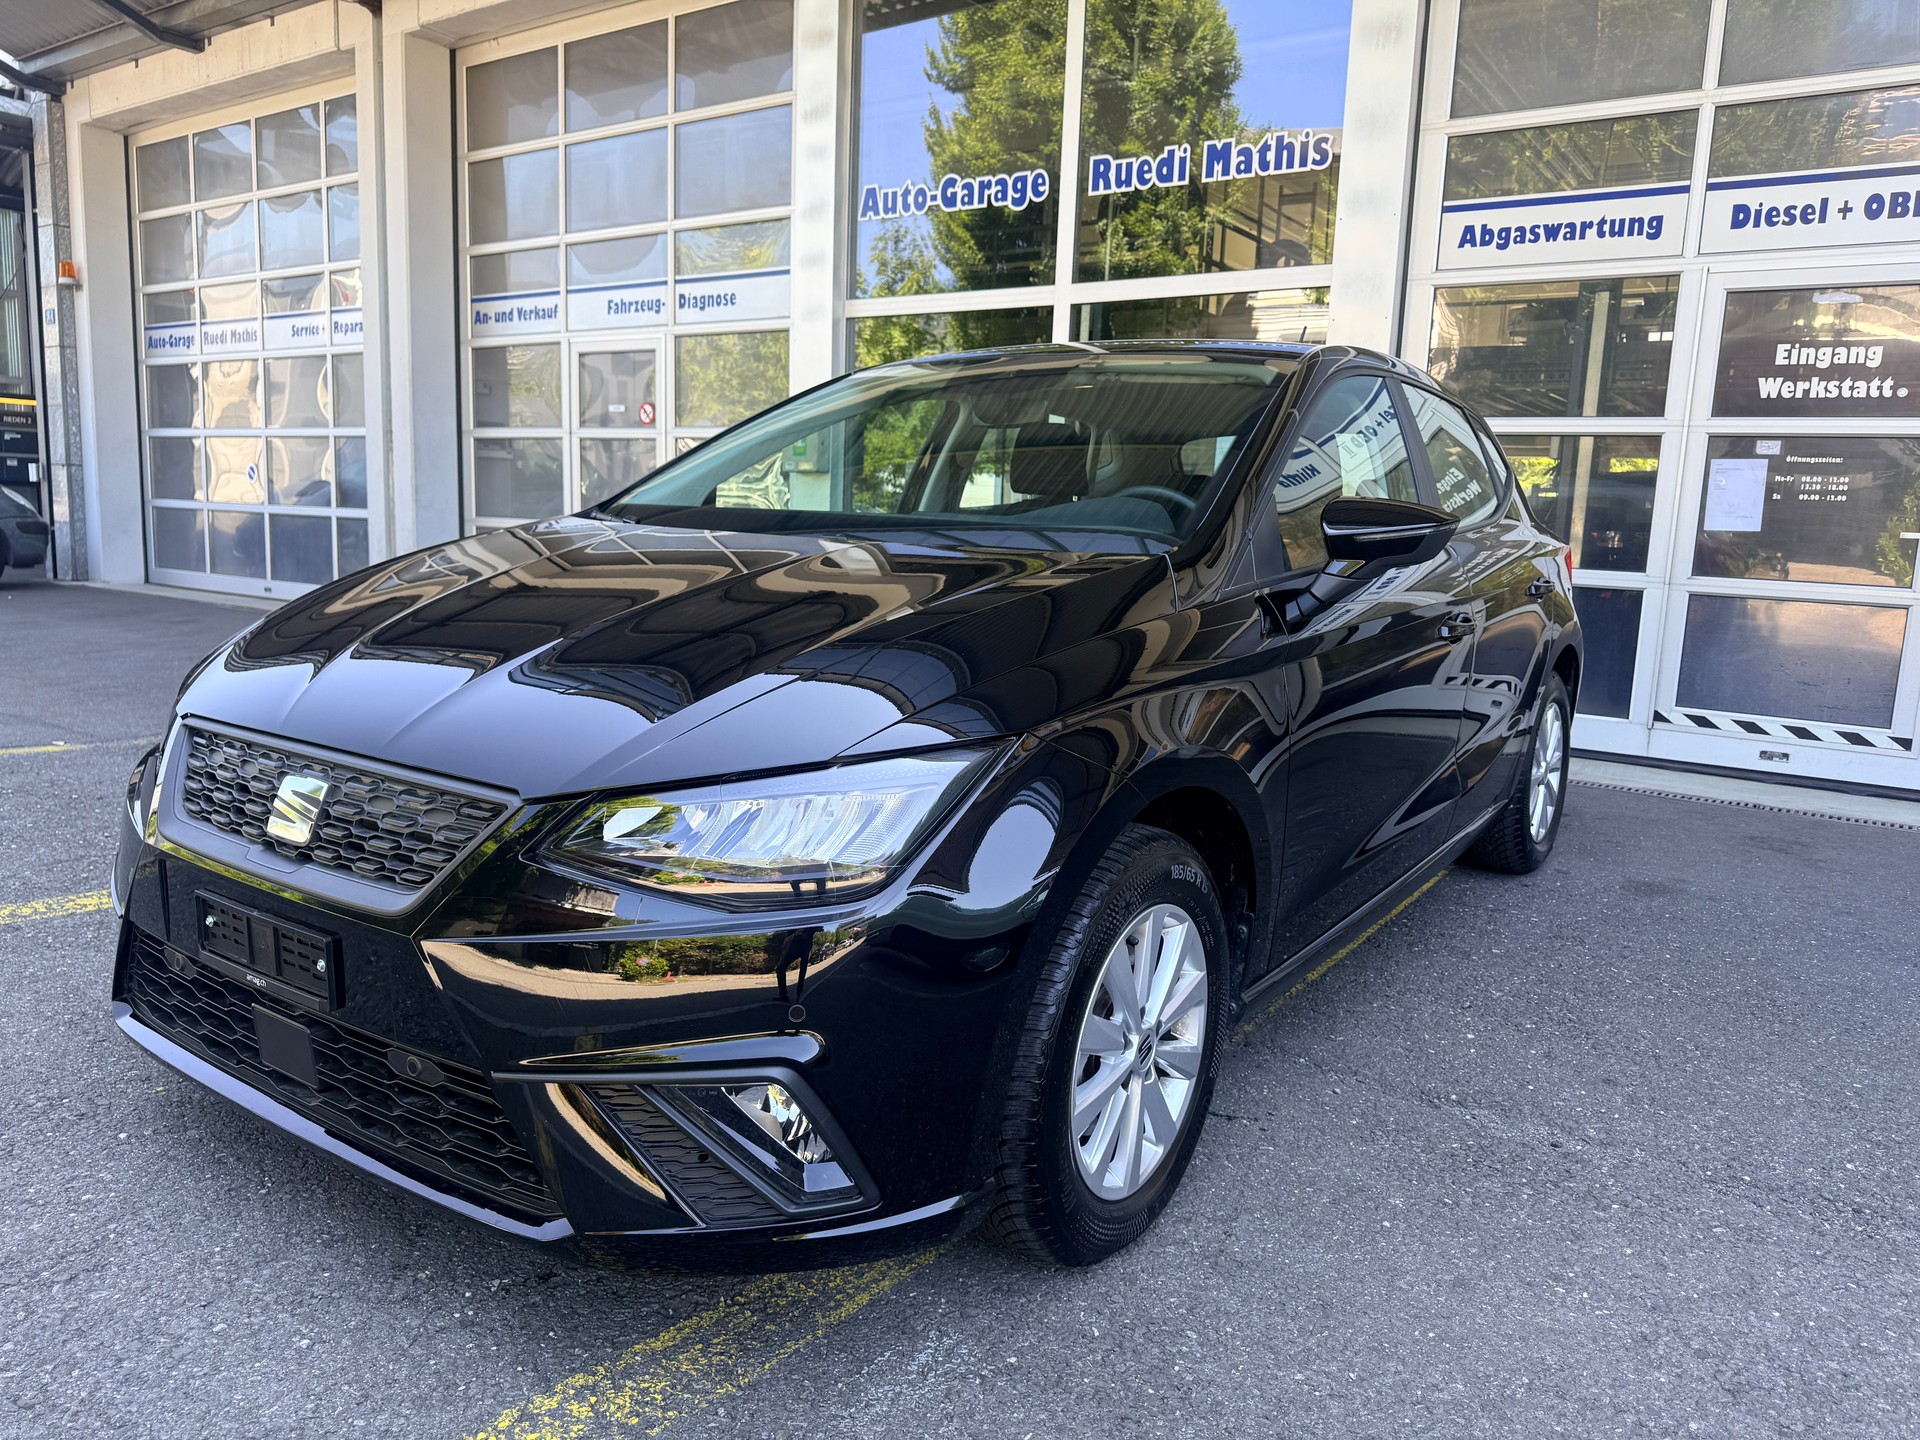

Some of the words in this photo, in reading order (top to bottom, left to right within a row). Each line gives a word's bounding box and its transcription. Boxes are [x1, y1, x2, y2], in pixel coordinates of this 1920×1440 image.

[859, 169, 1048, 219] Auto-Garage
[1089, 144, 1190, 195] Ruedi
[1202, 128, 1333, 182] Mathis
[1730, 197, 1829, 230] Diesel
[1837, 200, 1853, 220] +
[1458, 214, 1664, 250] Abgaswartung
[474, 310, 492, 325] An-
[494, 307, 514, 323] und
[517, 303, 558, 321] Verkauf
[607, 298, 665, 315] Fahrzeug-
[678, 292, 736, 311] Diagnose
[148, 334, 195, 350] Auto-Garage
[204, 329, 227, 346] Ruedi
[230, 327, 258, 344] Mathis
[291, 322, 320, 338] Service
[1775, 343, 1883, 369] Eingang
[3, 415, 26, 424] RIEDEN
[1785, 455, 1844, 464] Öffnungszeiten:
[1171, 864, 1196, 883] 185/65
[1195, 872, 1202, 888] R
[246, 973, 267, 988] amag.ch
